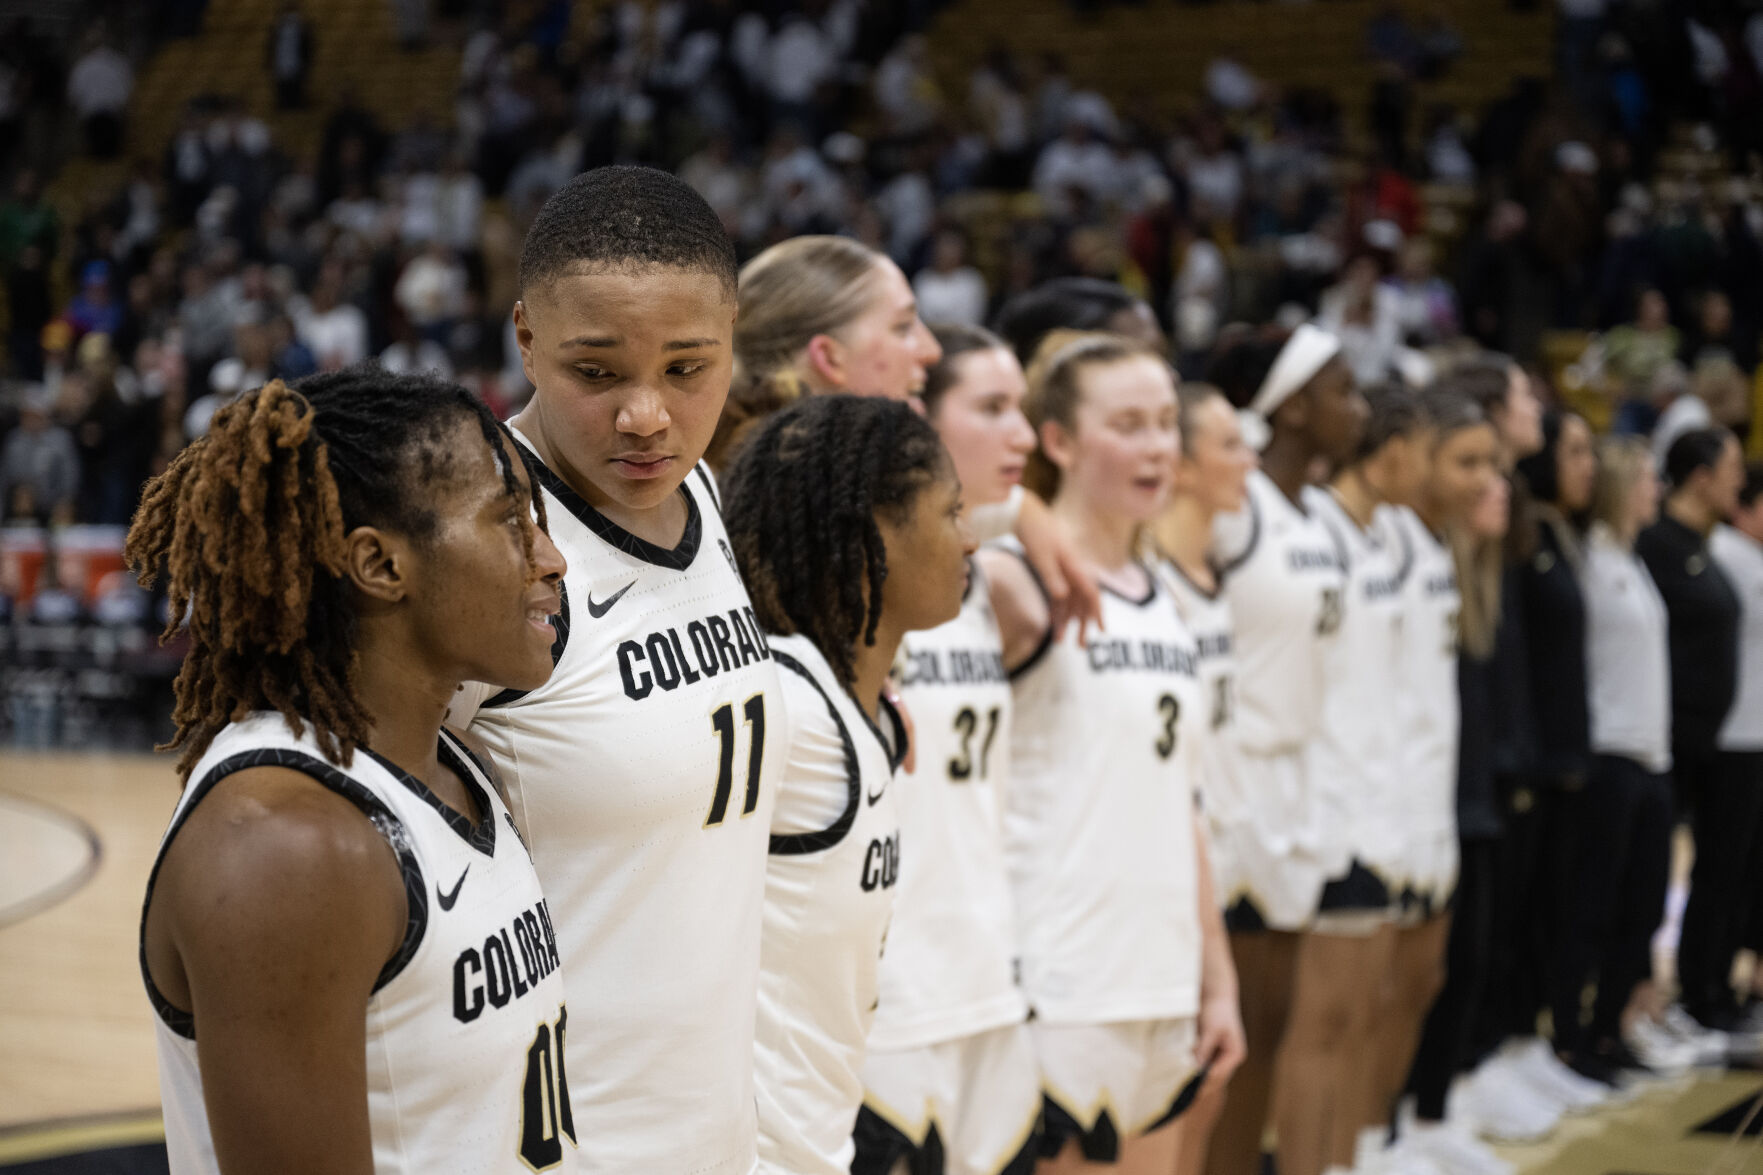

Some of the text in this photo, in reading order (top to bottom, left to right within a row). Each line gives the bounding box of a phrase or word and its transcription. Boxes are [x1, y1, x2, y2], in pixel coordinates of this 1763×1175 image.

[703, 691, 765, 830] 11
[947, 705, 1001, 782] 31
[1156, 693, 1179, 760] 3
